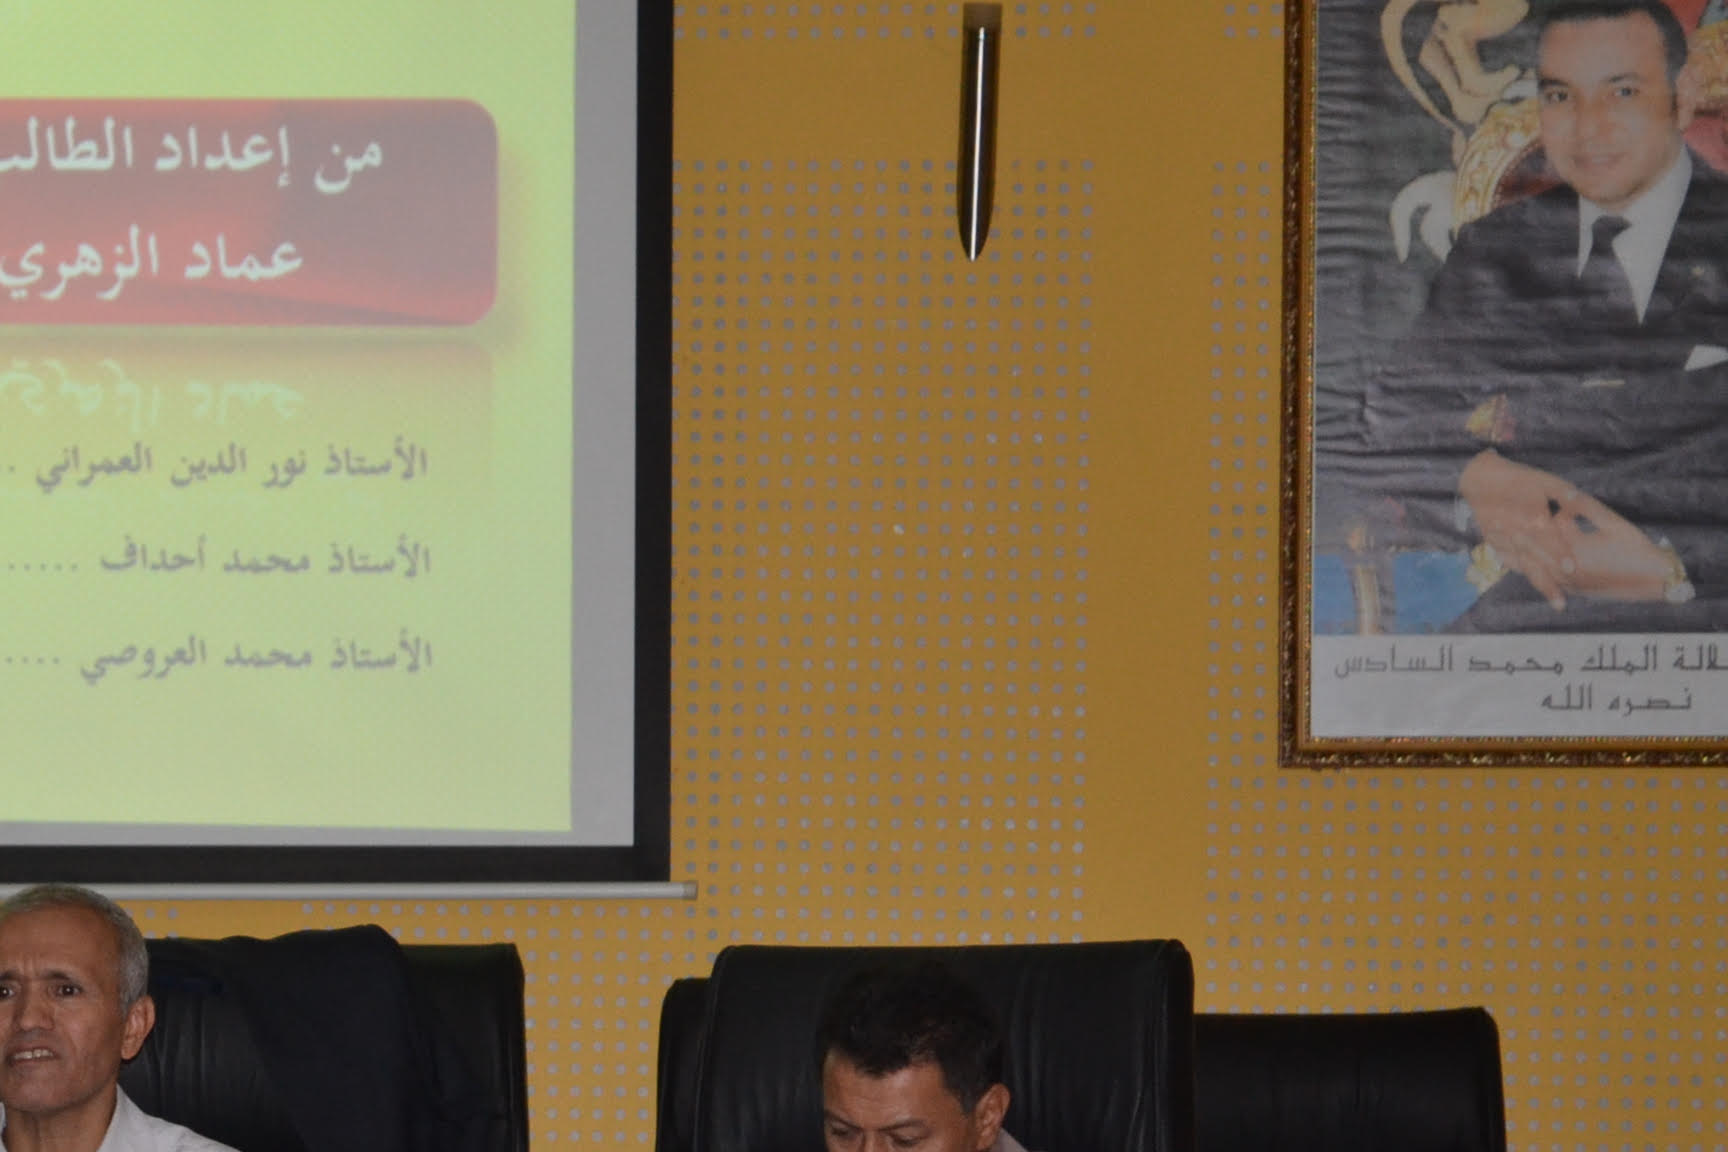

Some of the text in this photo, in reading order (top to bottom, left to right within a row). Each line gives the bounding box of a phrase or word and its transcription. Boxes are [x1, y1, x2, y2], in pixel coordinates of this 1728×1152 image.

[155, 127, 289, 187] إعداد
[314, 142, 383, 194] من
[184, 235, 303, 282] عماد
[35, 441, 153, 495] العمراني
[169, 442, 247, 489] الدين
[262, 450, 307, 489] نور
[324, 435, 428, 481] الأستاذ
[99, 534, 206, 573] أحداف
[222, 550, 311, 575] محمد
[327, 533, 431, 579] الأستاذ
[79, 634, 207, 686] العروصي
[223, 645, 313, 669] محمد
[329, 627, 433, 674] الأستاذ
[1334, 643, 1728, 680] لالة الملك محمد السادس
[1540, 684, 1693, 716] نصره الله
